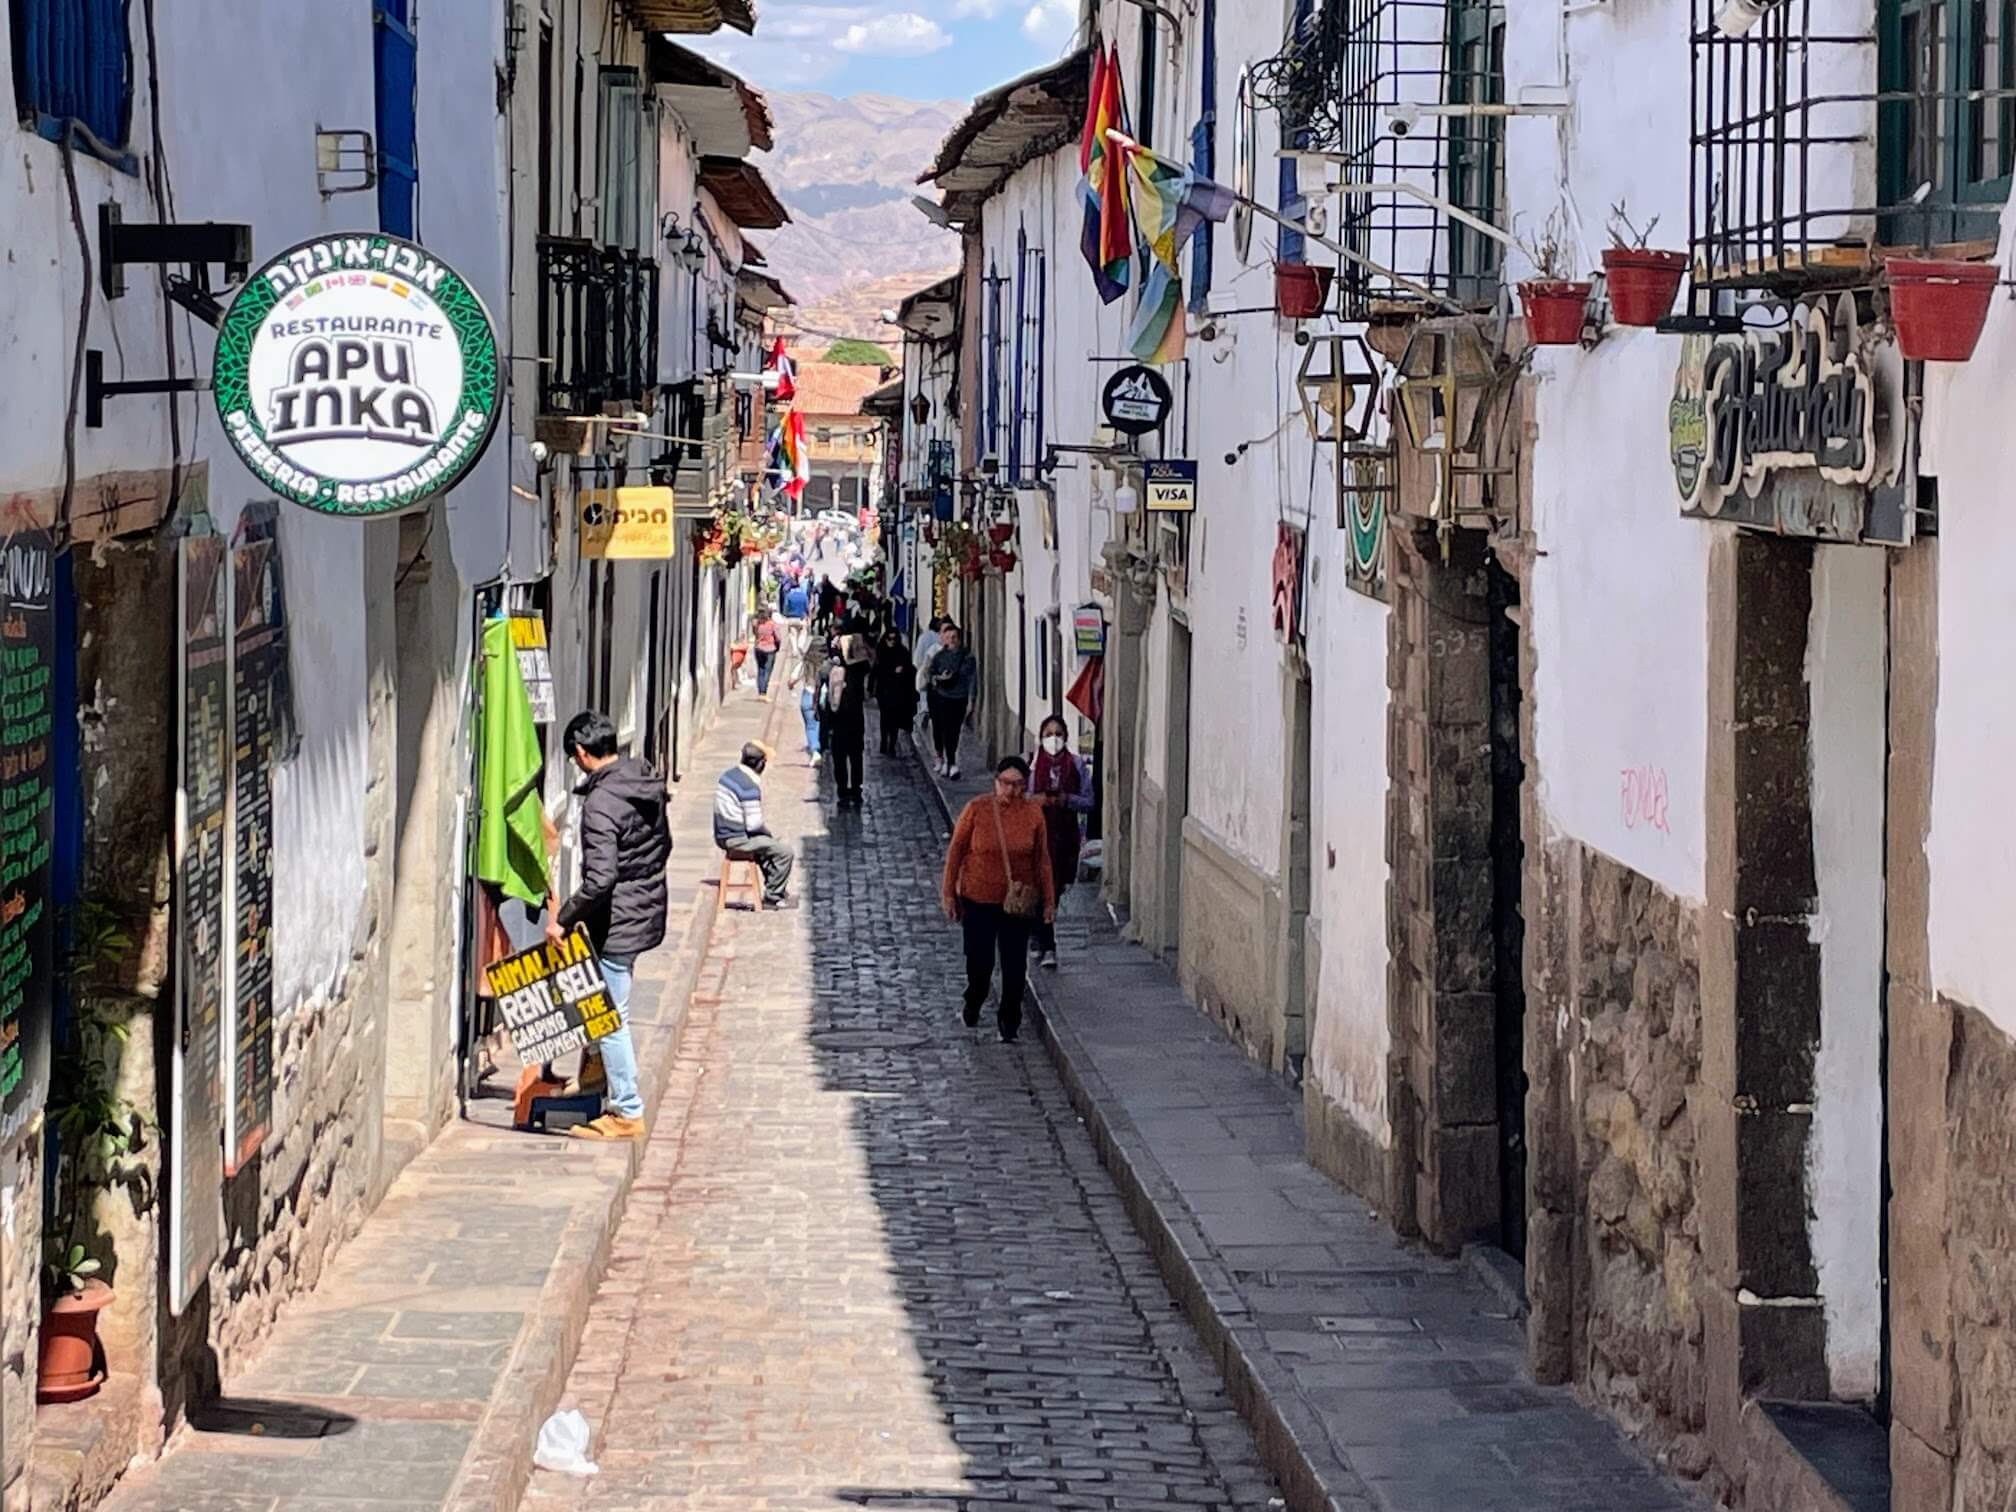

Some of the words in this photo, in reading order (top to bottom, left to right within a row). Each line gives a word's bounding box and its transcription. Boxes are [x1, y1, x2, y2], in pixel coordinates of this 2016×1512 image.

[271, 316, 444, 340] RESTAURANTE
[294, 340, 410, 385] APU
[273, 385, 433, 436] INKA
[226, 409, 319, 497] PIZZERIA
[335, 408, 485, 504] RESTAURANTE
[1155, 488, 1188, 501] VISA
[487, 931, 591, 996] HIMALAYA
[499, 979, 555, 1029] RENT
[556, 958, 606, 1003] SELL
[577, 993, 607, 1018] THE
[511, 1011, 568, 1049] CAMPING
[520, 1024, 588, 1065] EQUIPMENT
[585, 1009, 621, 1040] BEST
